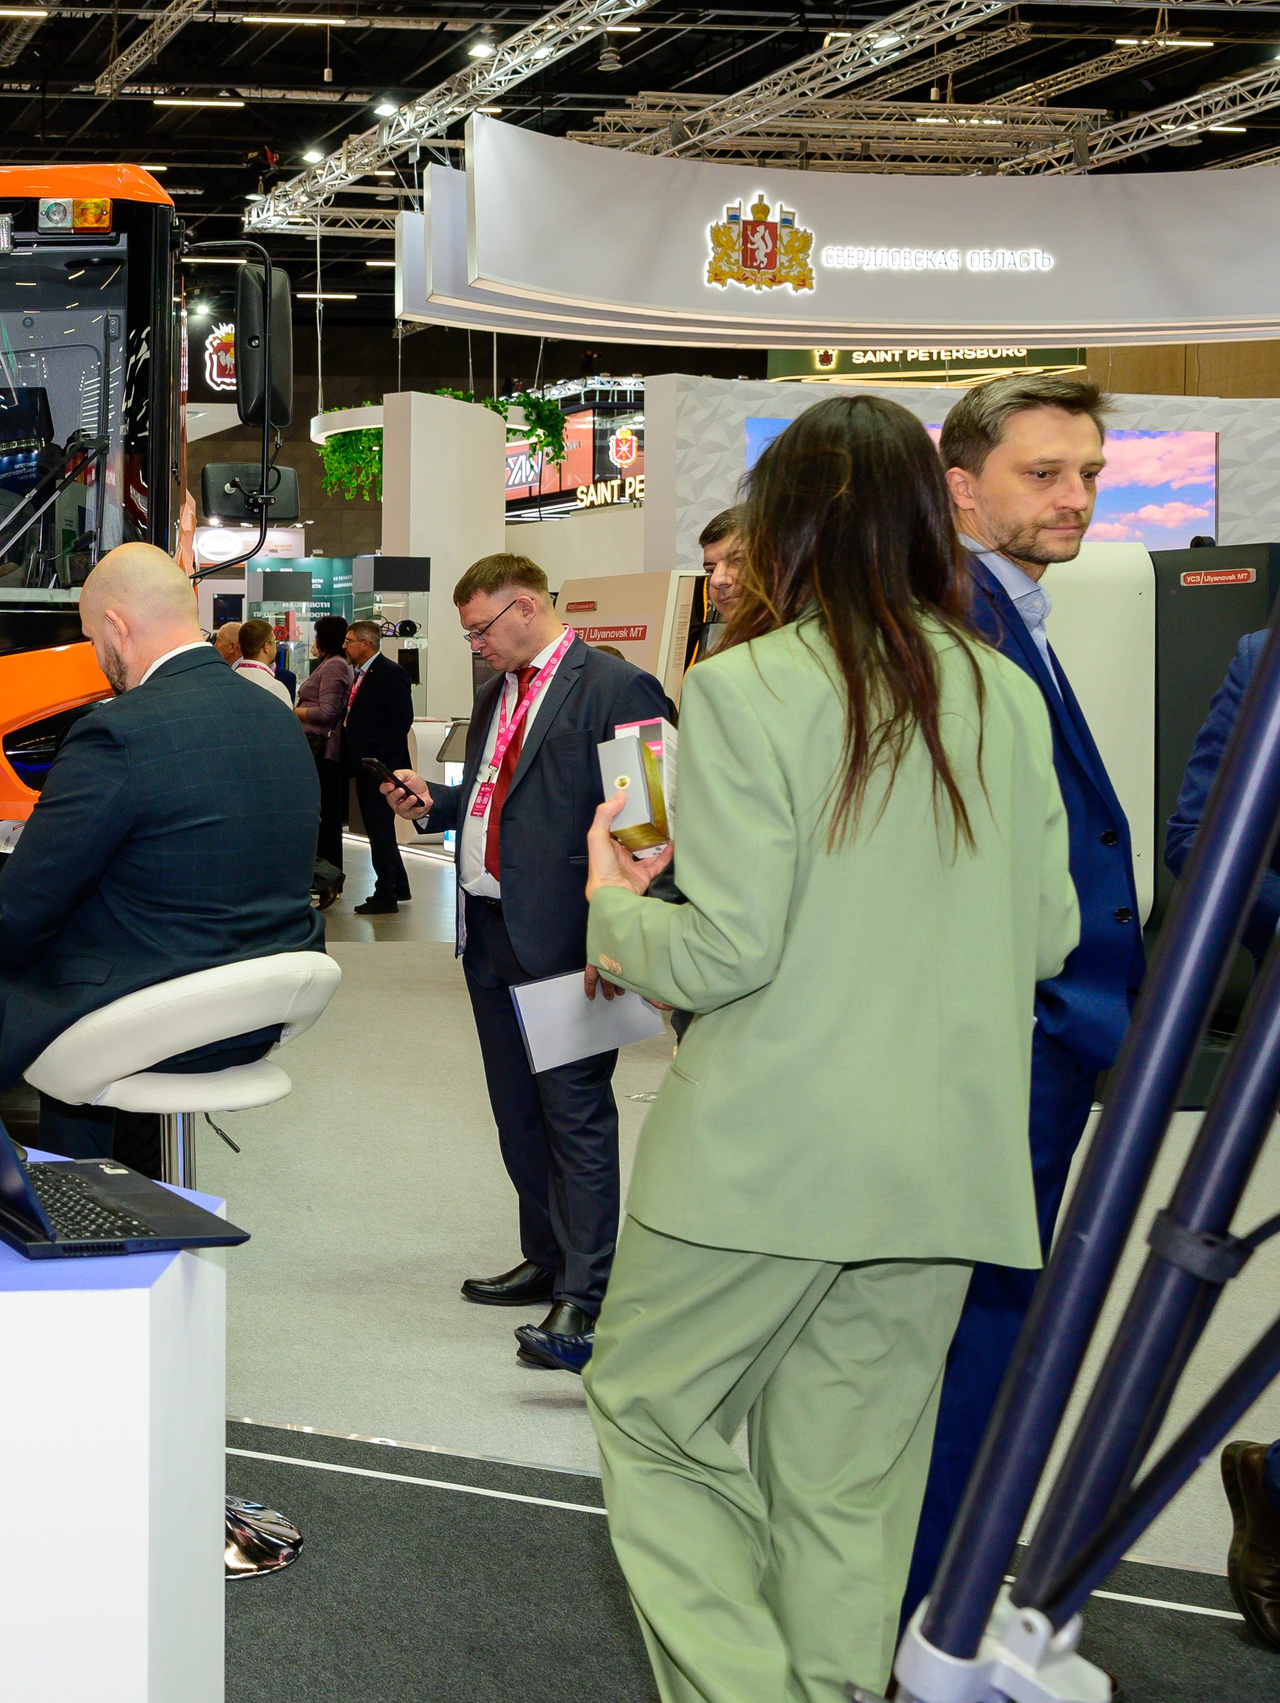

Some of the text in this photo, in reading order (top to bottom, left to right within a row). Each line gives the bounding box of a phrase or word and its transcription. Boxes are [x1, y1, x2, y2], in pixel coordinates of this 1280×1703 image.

[823, 246, 1053, 271] СВЕРДЛОВСКАЯ ОБЛАСТЬ
[851, 348, 1028, 364] SAINT PETERSBURG
[576, 479, 621, 508] SAINT
[629, 626, 644, 638] MT
